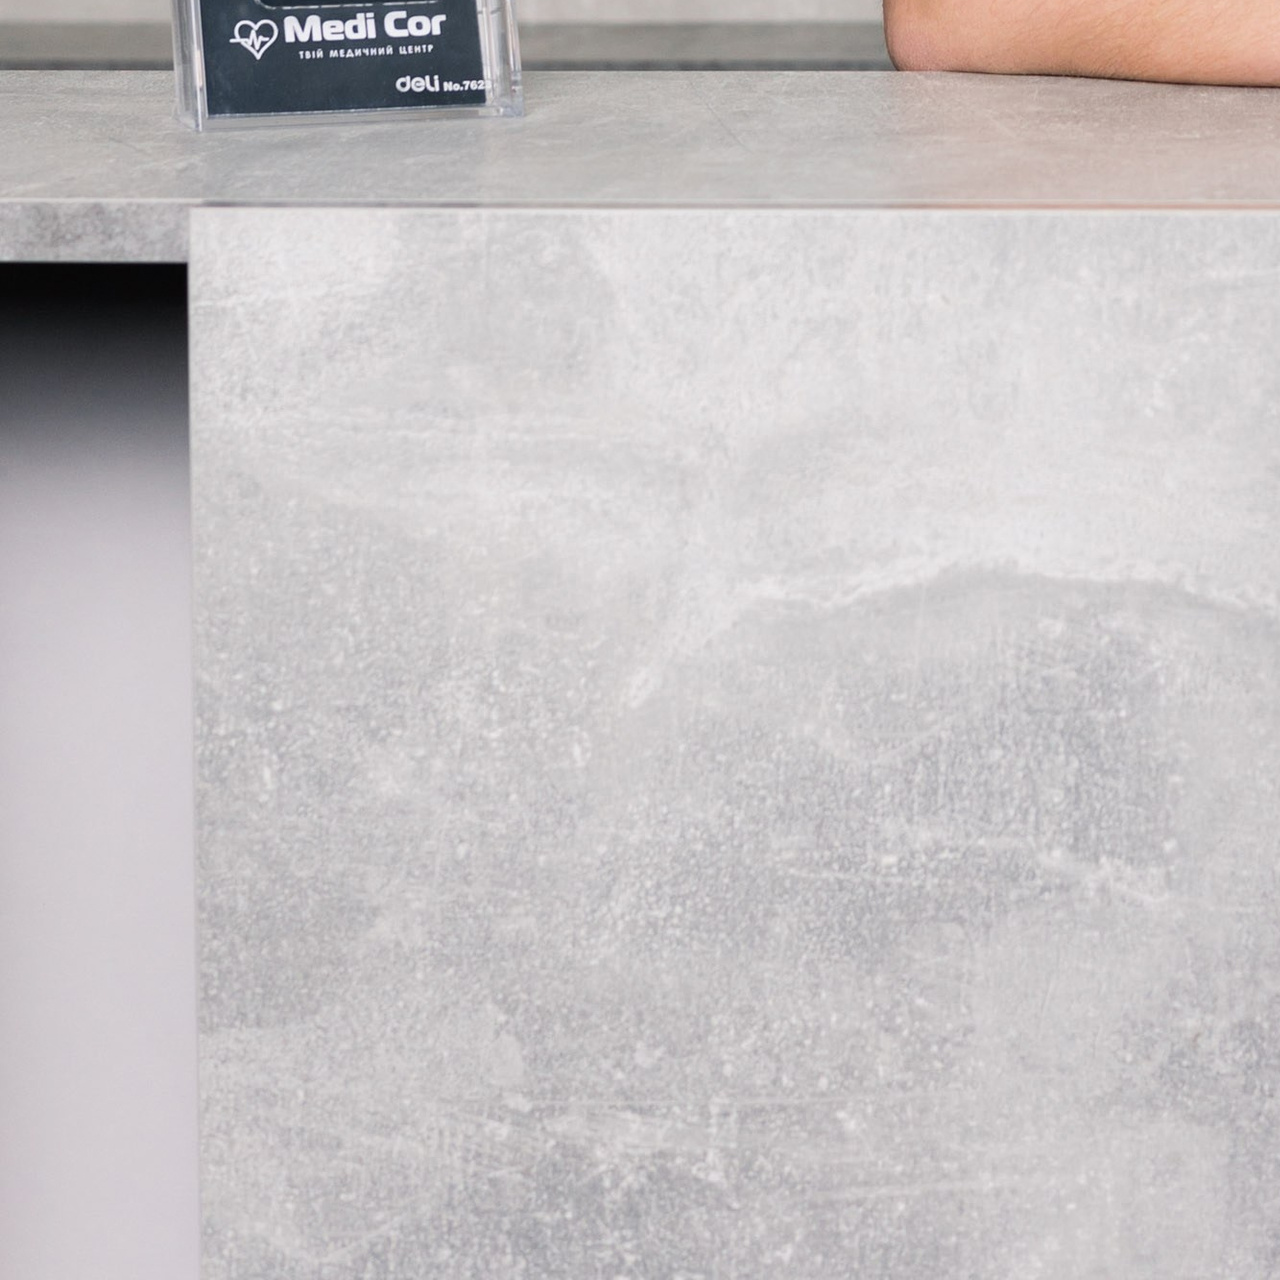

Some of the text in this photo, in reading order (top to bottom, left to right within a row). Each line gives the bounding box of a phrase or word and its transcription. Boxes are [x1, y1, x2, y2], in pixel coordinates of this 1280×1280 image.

[283, 10, 447, 43] Medi Cor
[298, 44, 434, 60] ТВІЙ МЕДИЧНИЙ ЦЕНТР
